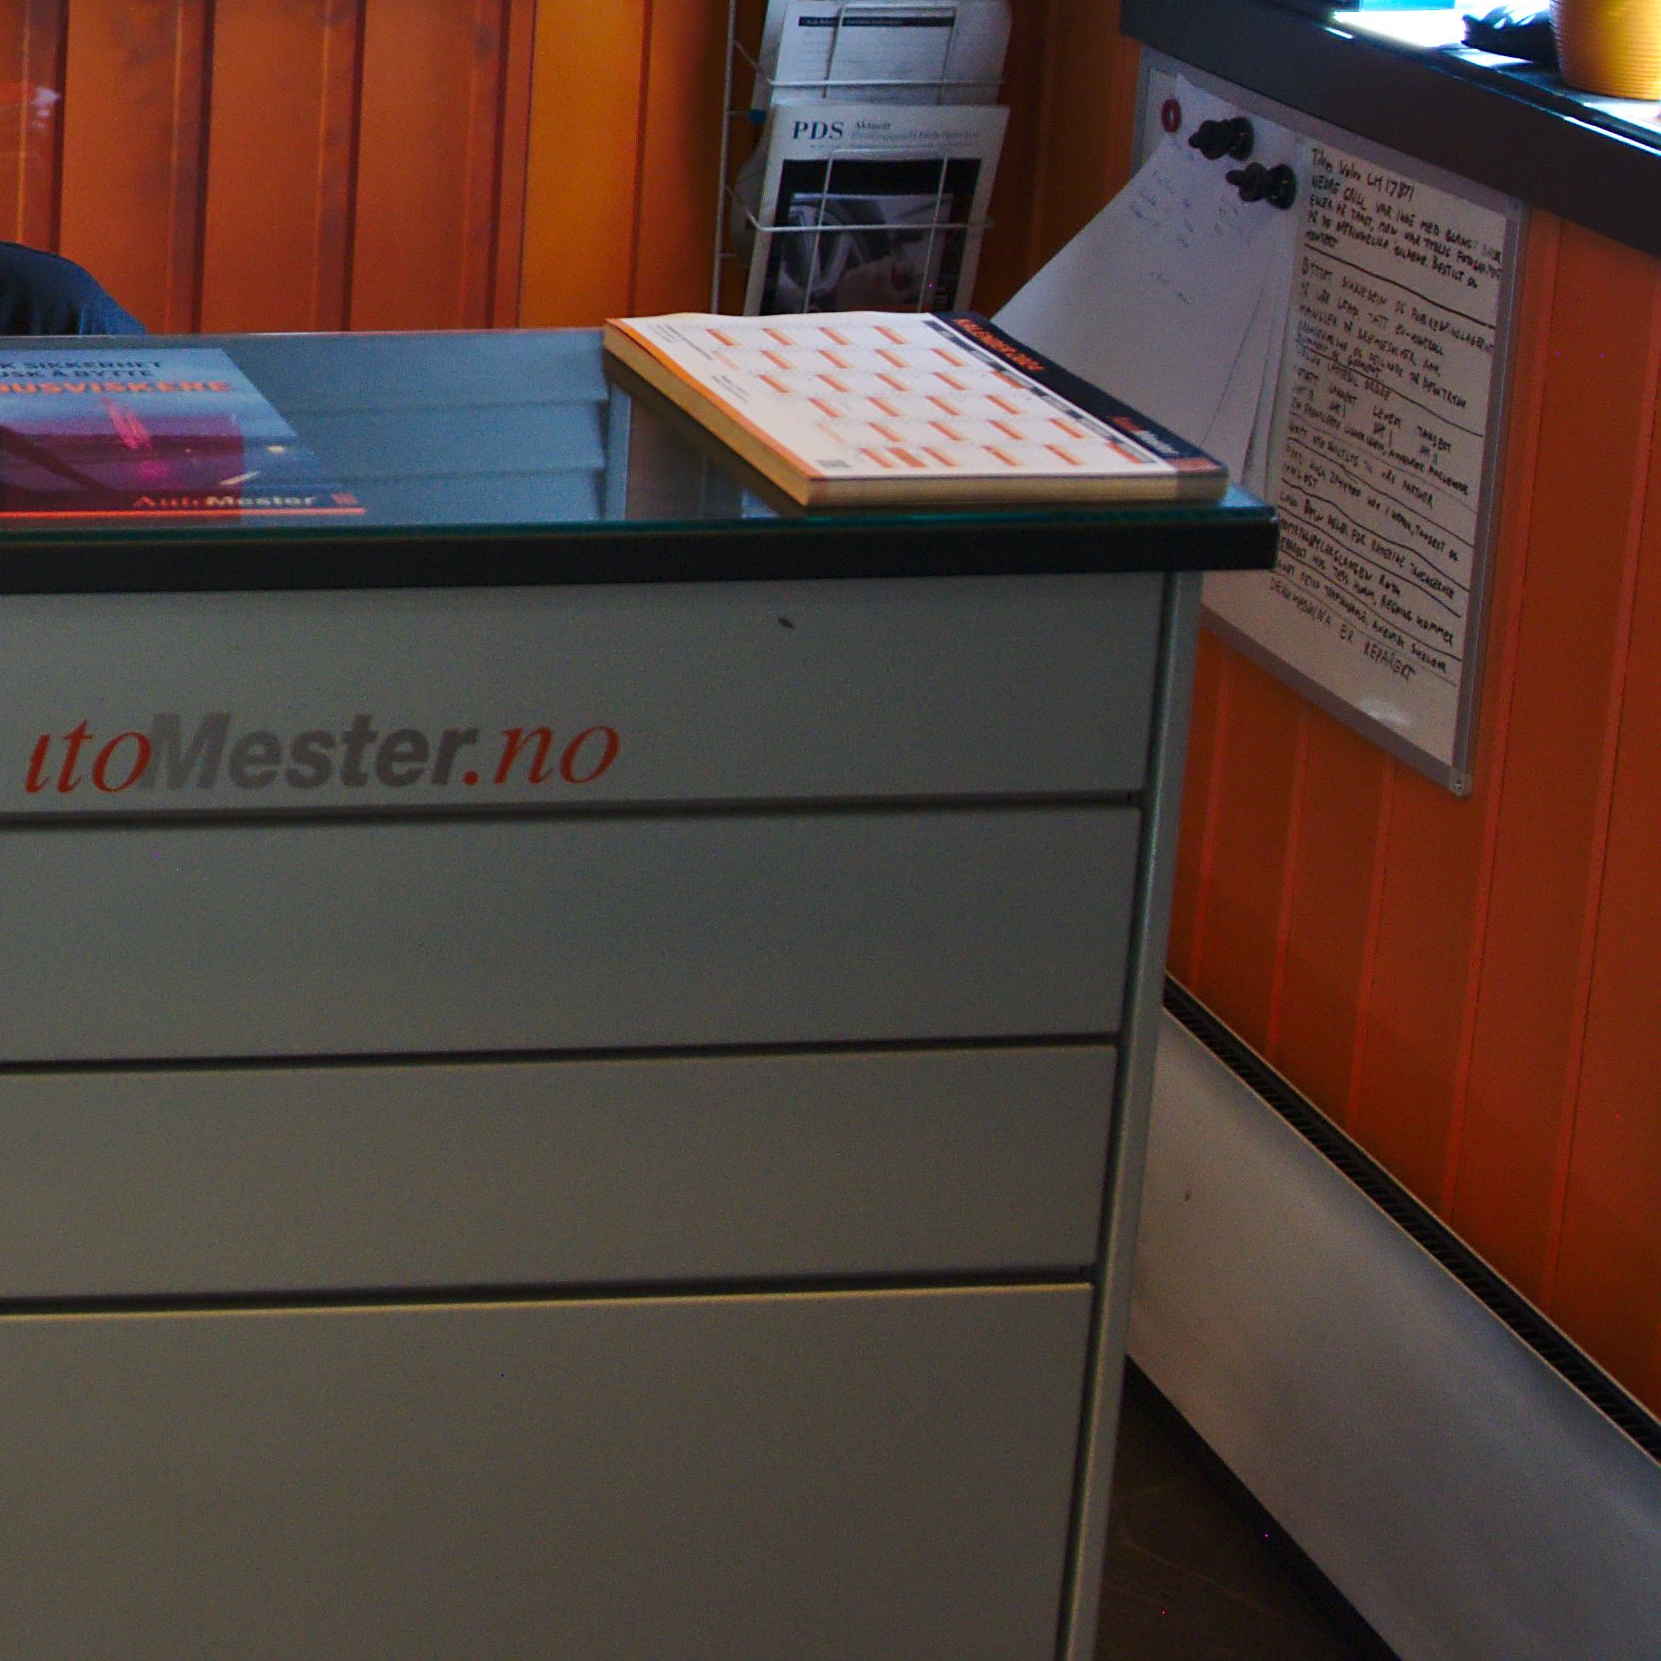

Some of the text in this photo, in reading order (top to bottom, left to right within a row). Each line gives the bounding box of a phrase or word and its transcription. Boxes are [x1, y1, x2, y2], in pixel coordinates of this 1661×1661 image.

[793, 121, 846, 139] PDS
[73, 369, 154, 377] BYTTE
[133, 490, 319, 509] AutoMester
